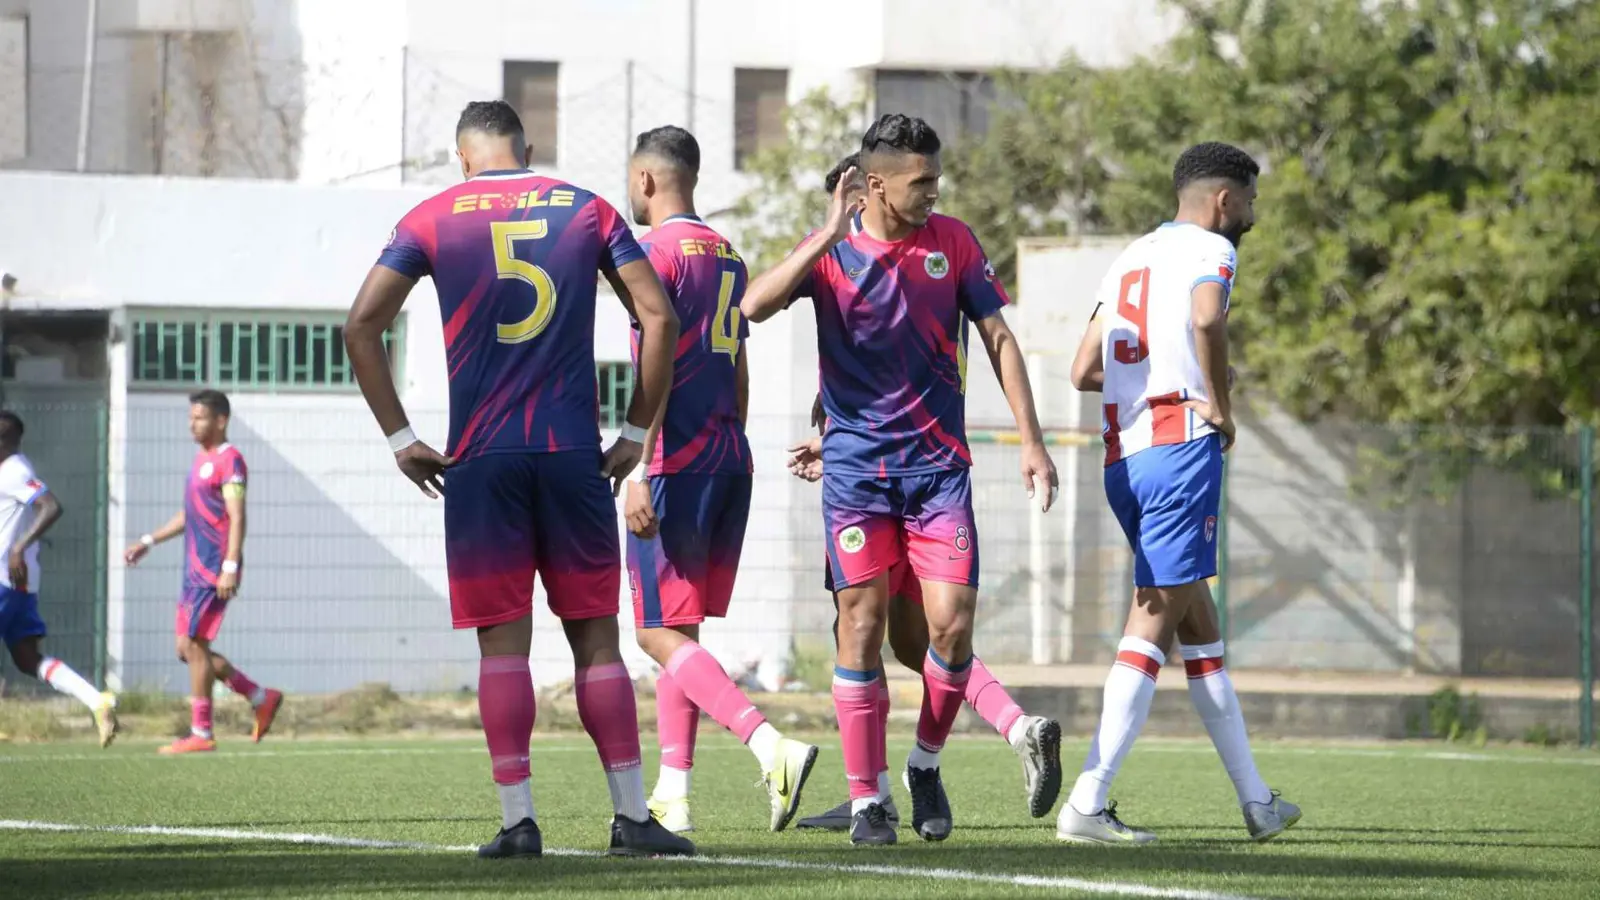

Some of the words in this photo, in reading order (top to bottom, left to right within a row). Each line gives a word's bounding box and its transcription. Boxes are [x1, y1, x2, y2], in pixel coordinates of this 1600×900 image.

[490, 218, 557, 344] 5
[711, 271, 740, 367] 4
[1114, 266, 1151, 364] 9
[954, 525, 970, 553] 8
